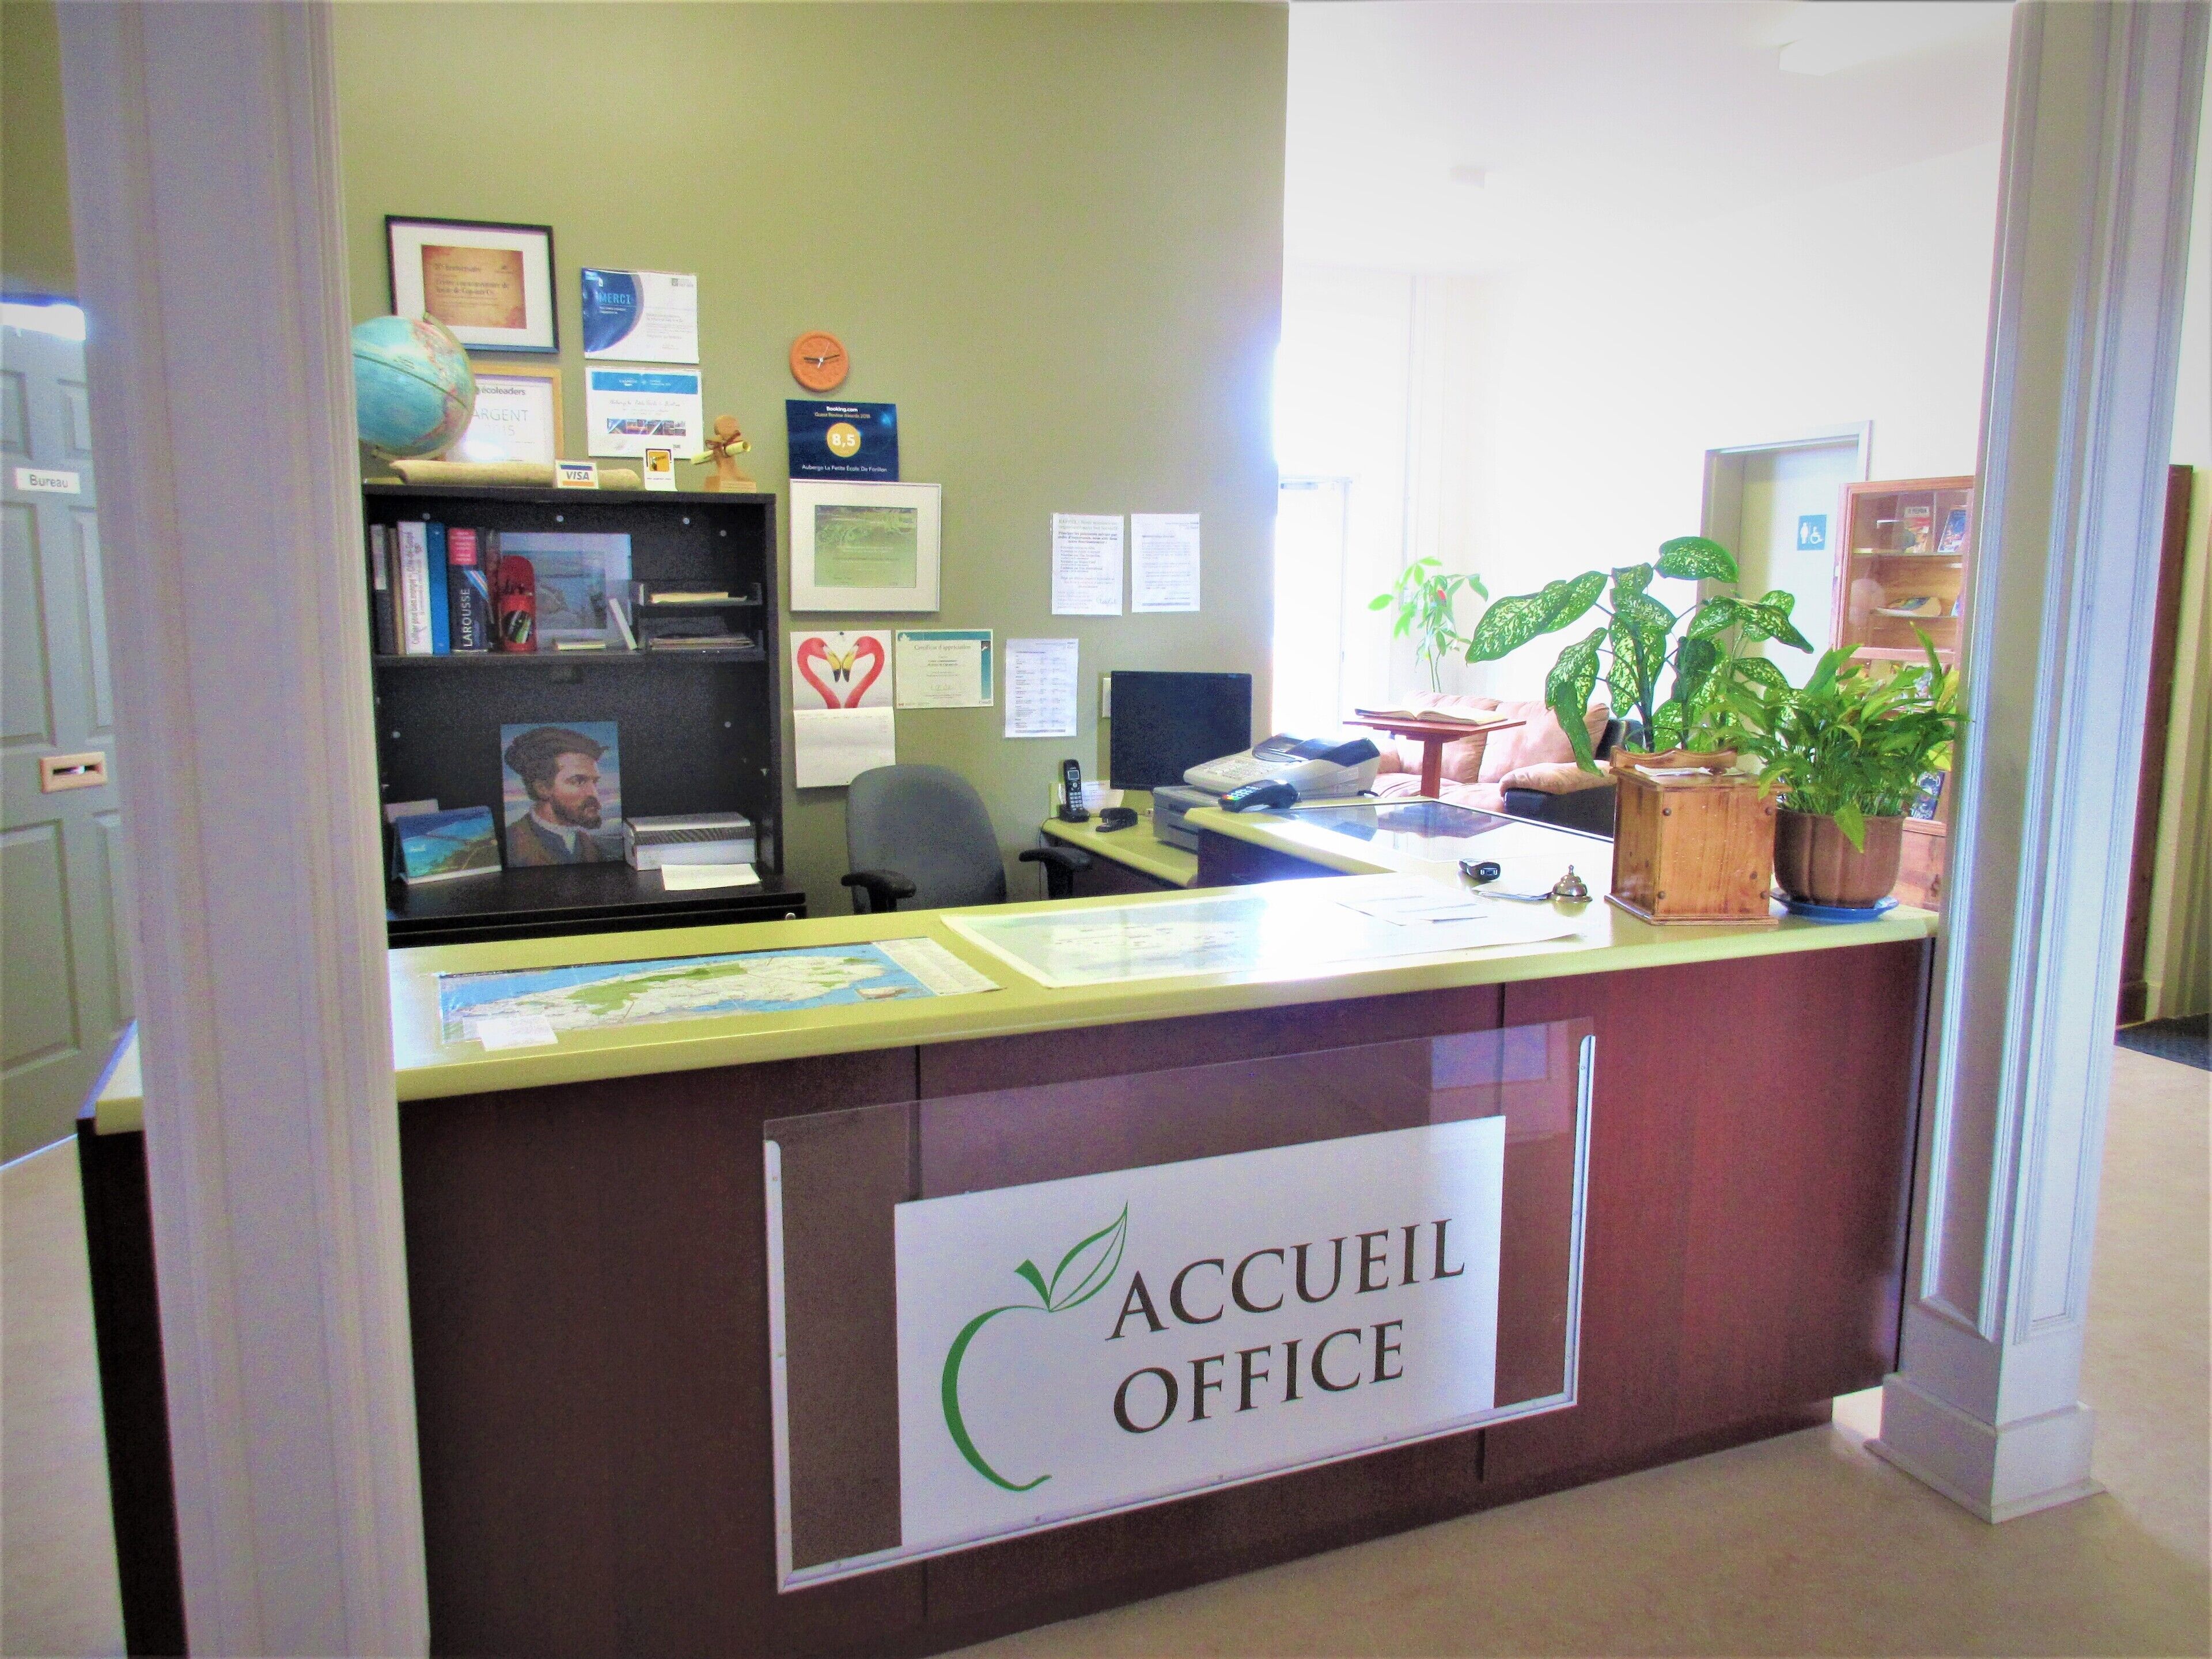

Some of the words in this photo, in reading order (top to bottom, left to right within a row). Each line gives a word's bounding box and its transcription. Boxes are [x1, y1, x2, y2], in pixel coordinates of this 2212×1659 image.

[599, 292, 631, 304] MERCI
[832, 433, 856, 448] 8,5
[29, 474, 69, 488] Bureau
[566, 471, 590, 480] VISA
[460, 588, 472, 647] LAROUSSE
[1104, 1218, 1464, 1340] ACCUEIL
[1113, 1319, 1404, 1434] OFFICE
